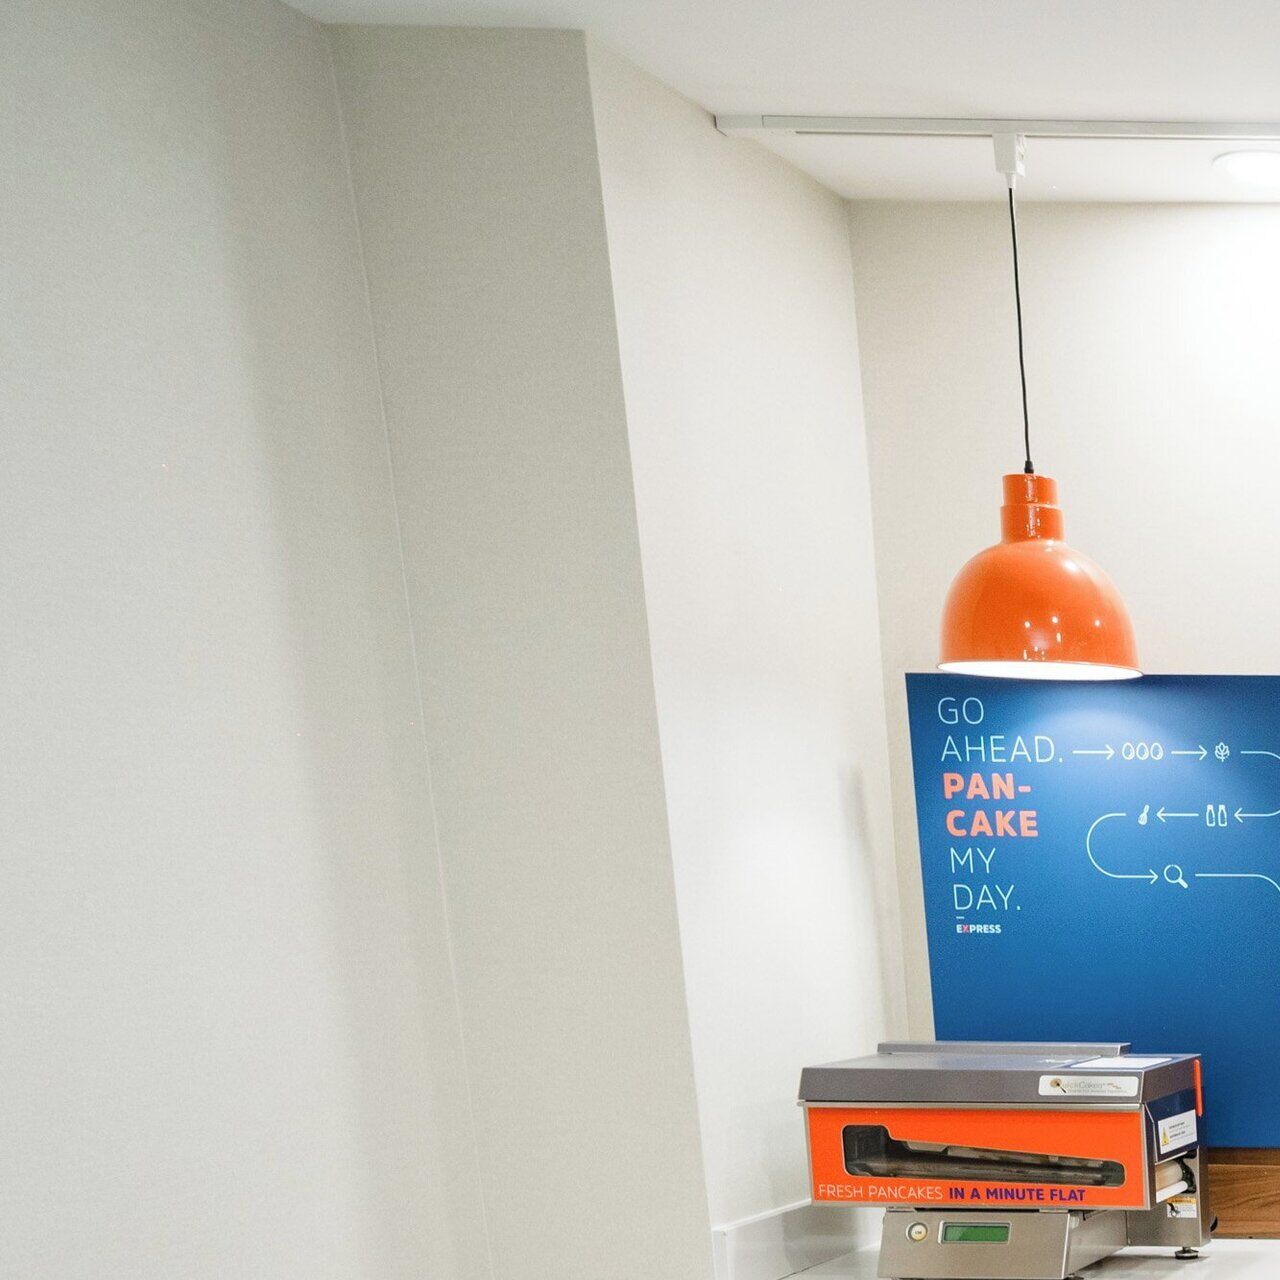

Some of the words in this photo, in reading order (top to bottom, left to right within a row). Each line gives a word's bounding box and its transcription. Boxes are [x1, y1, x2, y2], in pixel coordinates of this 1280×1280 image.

[937, 696, 985, 725] GO
[940, 735, 1064, 763] AHEAD.
[943, 772, 1032, 800] PAN-
[946, 809, 1039, 838] CAKE
[950, 847, 996, 874] MY
[953, 883, 1021, 911] DAY.
[956, 923, 1002, 934] EXPRESS
[818, 1184, 864, 1198] FRESH
[868, 1185, 944, 1200] PANCAKES
[949, 1187, 965, 1200] IN
[970, 1187, 981, 1200] A
[985, 1187, 1045, 1201] MINUTE
[1049, 1188, 1086, 1202] FLAT
